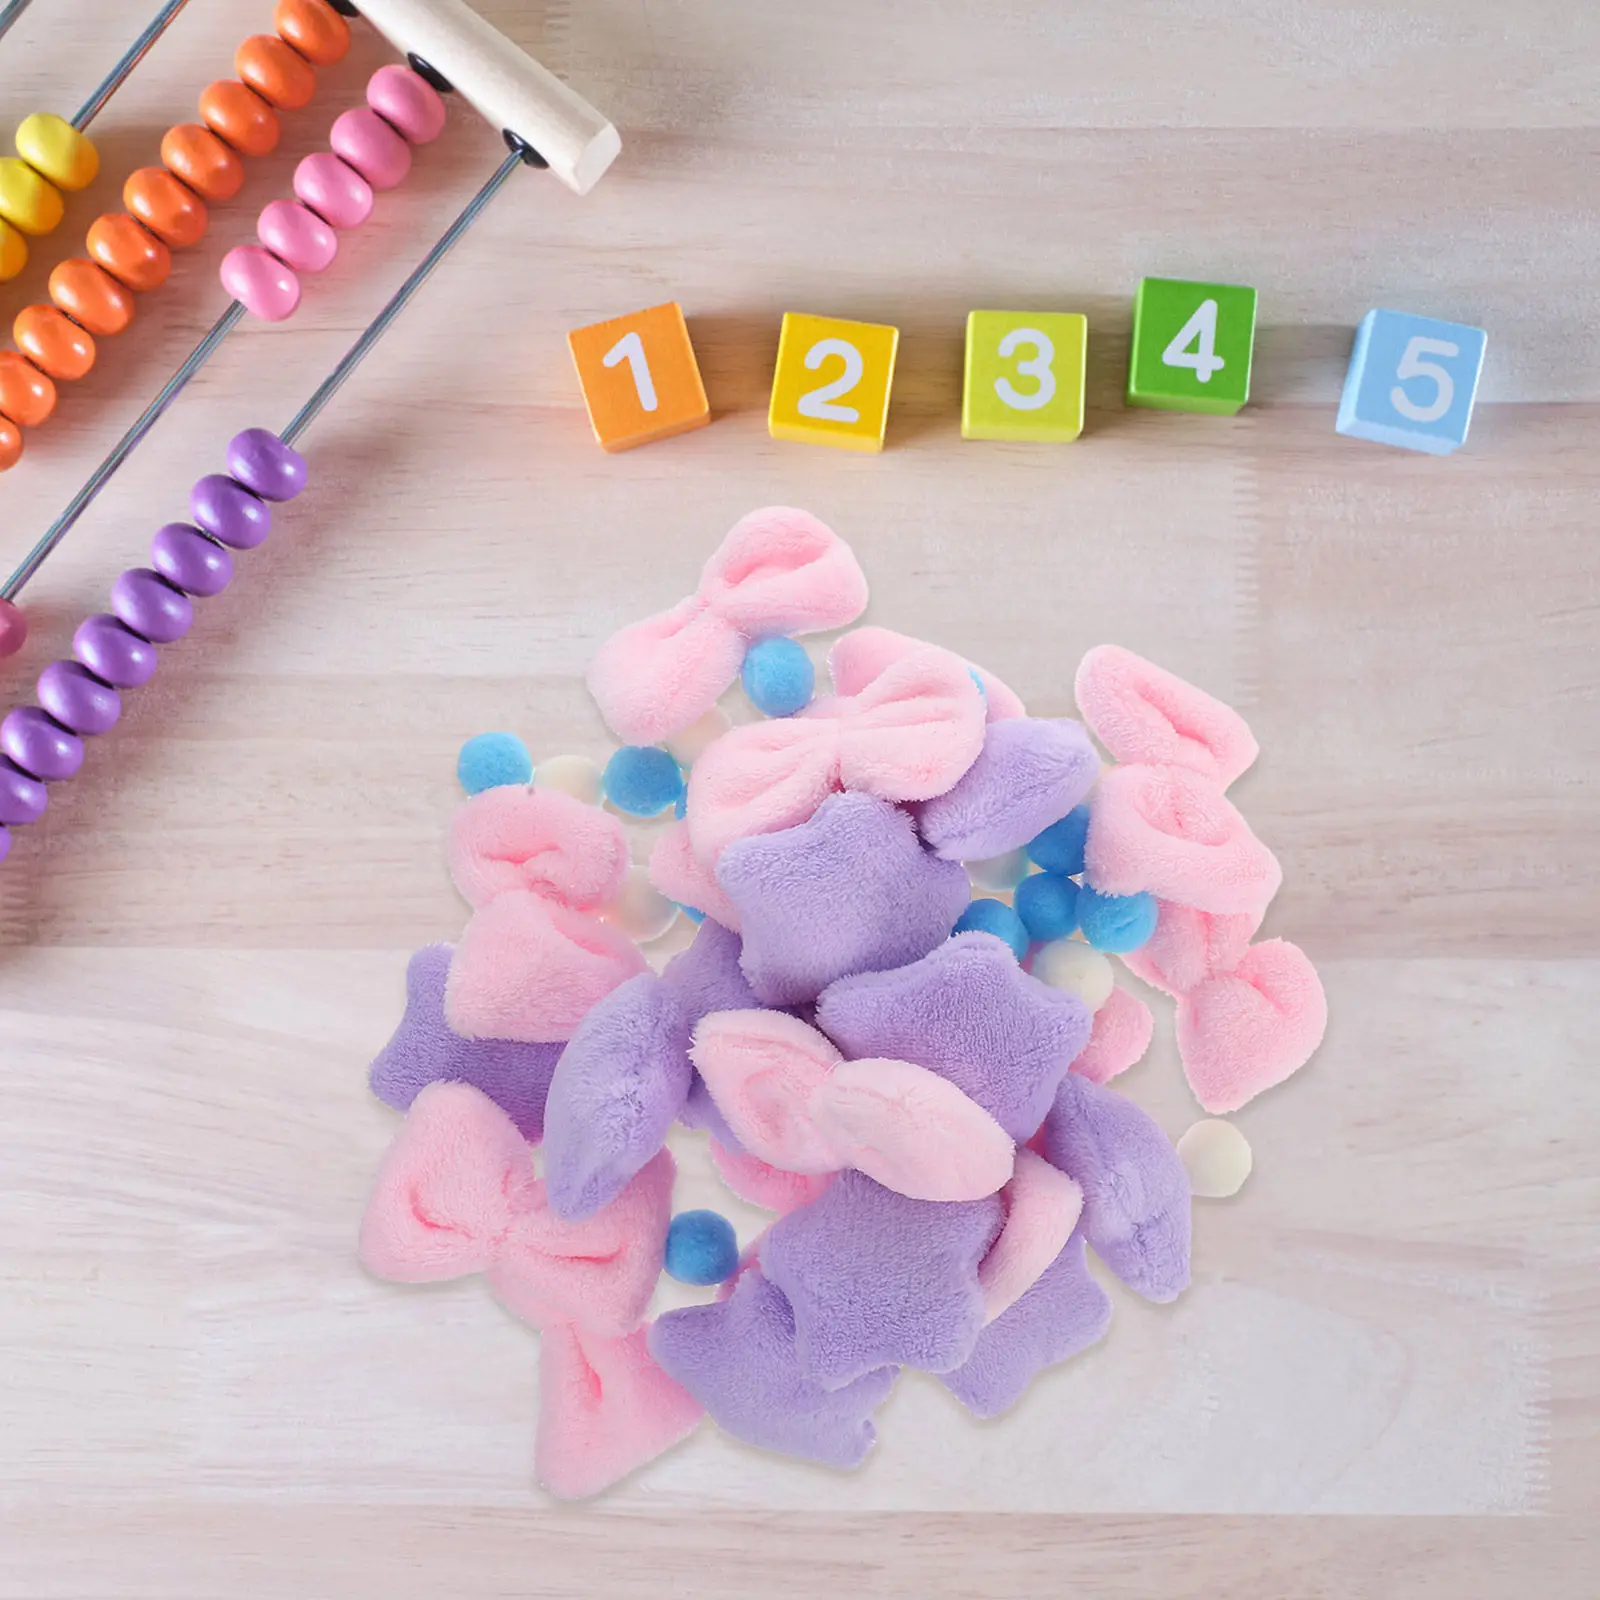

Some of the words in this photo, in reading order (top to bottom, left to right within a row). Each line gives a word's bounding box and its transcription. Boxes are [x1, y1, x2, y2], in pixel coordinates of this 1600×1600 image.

[602, 332, 658, 412] 1
[797, 338, 862, 423] 2
[993, 328, 1056, 410] 3
[1162, 299, 1225, 383] 4
[1390, 337, 1459, 423] 5
